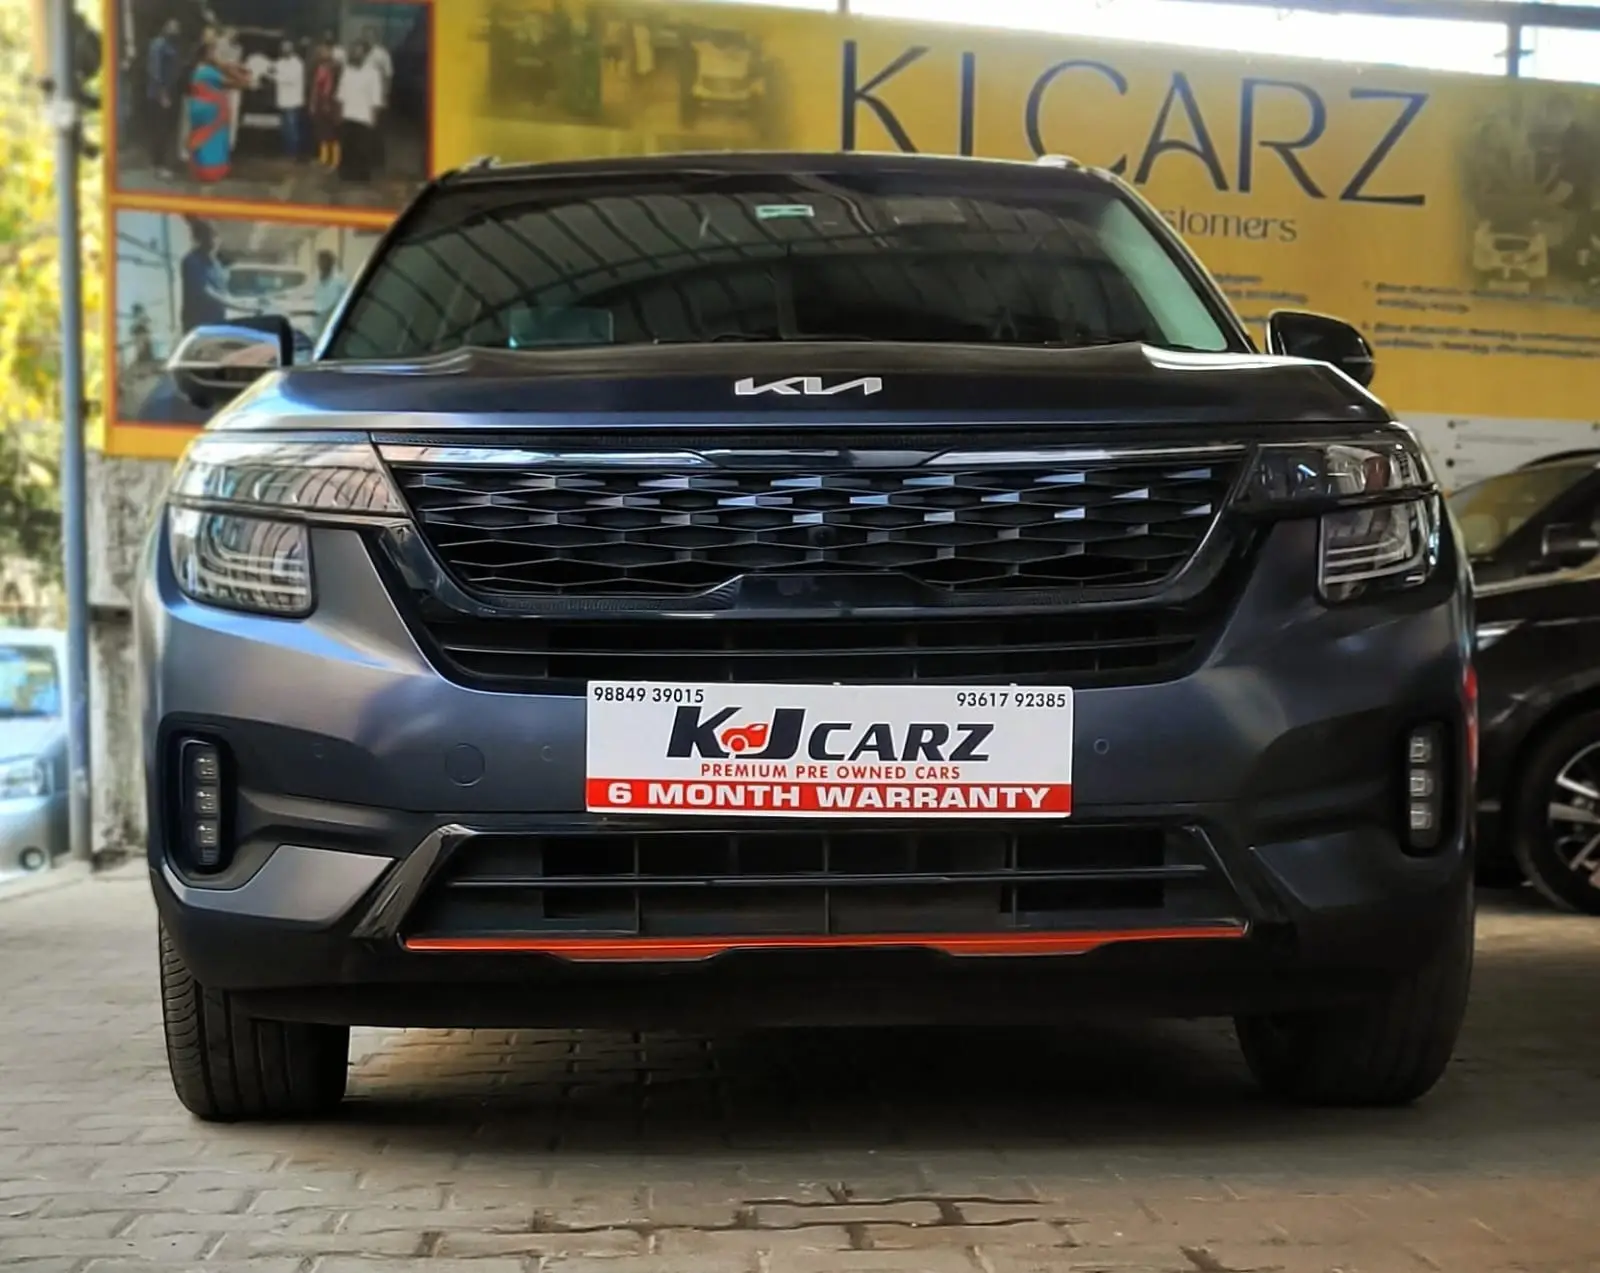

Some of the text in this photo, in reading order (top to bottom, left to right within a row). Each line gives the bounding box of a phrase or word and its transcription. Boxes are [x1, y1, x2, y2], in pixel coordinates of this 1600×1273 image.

[1025, 58, 1429, 205] CARZ
[594, 686, 704, 703] 98849 39015
[956, 692, 1066, 708] 93617 92385
[666, 705, 994, 761] KJ CARZ
[701, 763, 960, 780] PREMIUM PRE OWNED CARS
[608, 782, 1050, 809] 6 MONTH WARRANTY
